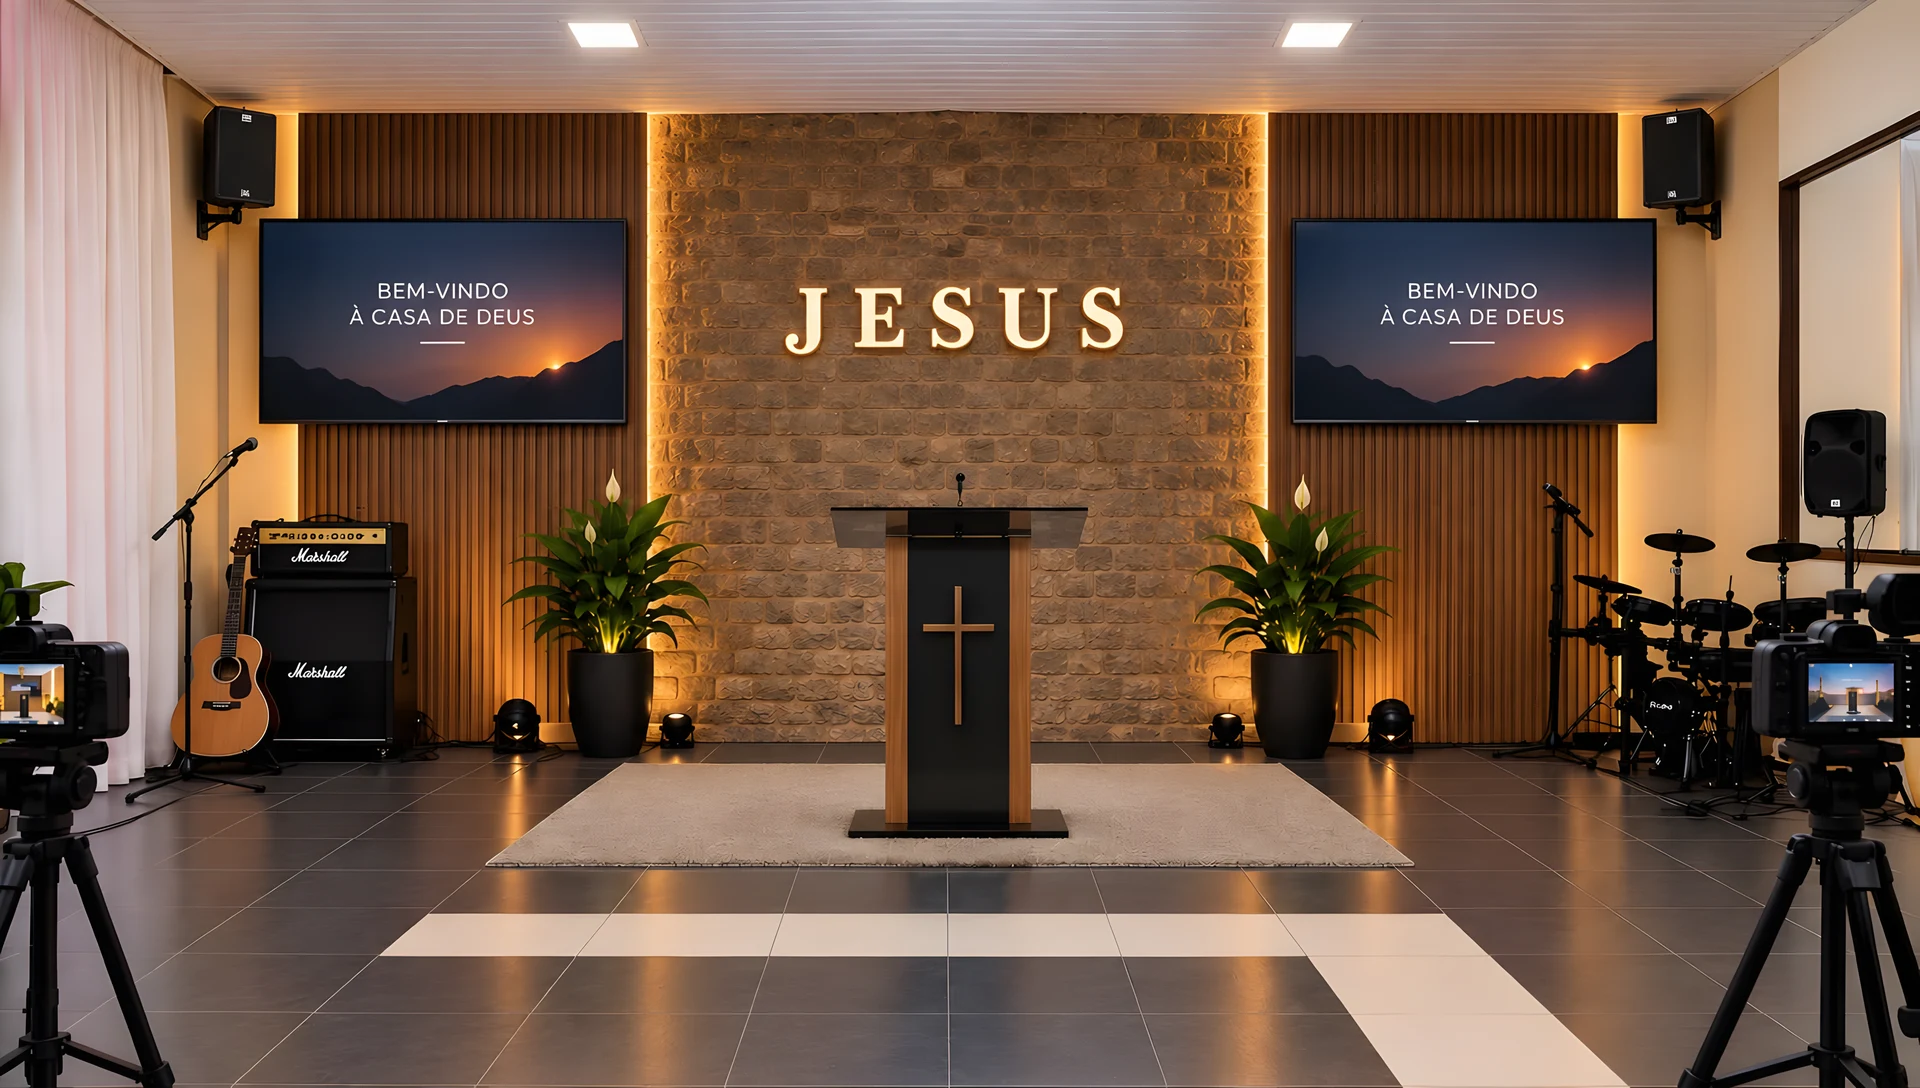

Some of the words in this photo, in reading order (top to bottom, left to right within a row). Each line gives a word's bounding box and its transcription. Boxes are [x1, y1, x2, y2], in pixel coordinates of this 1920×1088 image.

[378, 282, 509, 300] BEM-VINDO
[1408, 282, 1538, 300] BEM-VINDO
[349, 304, 364, 325] À
[371, 308, 432, 326] CASA
[440, 308, 468, 326] DE
[477, 308, 535, 326] DEUS
[784, 286, 1125, 355] JESUS
[1380, 304, 1395, 325] À
[1402, 308, 1462, 326] CASA
[1470, 308, 1498, 326] DE
[1506, 308, 1565, 326] DEUS
[291, 547, 350, 563] Marshall
[287, 662, 348, 679] Marshall
